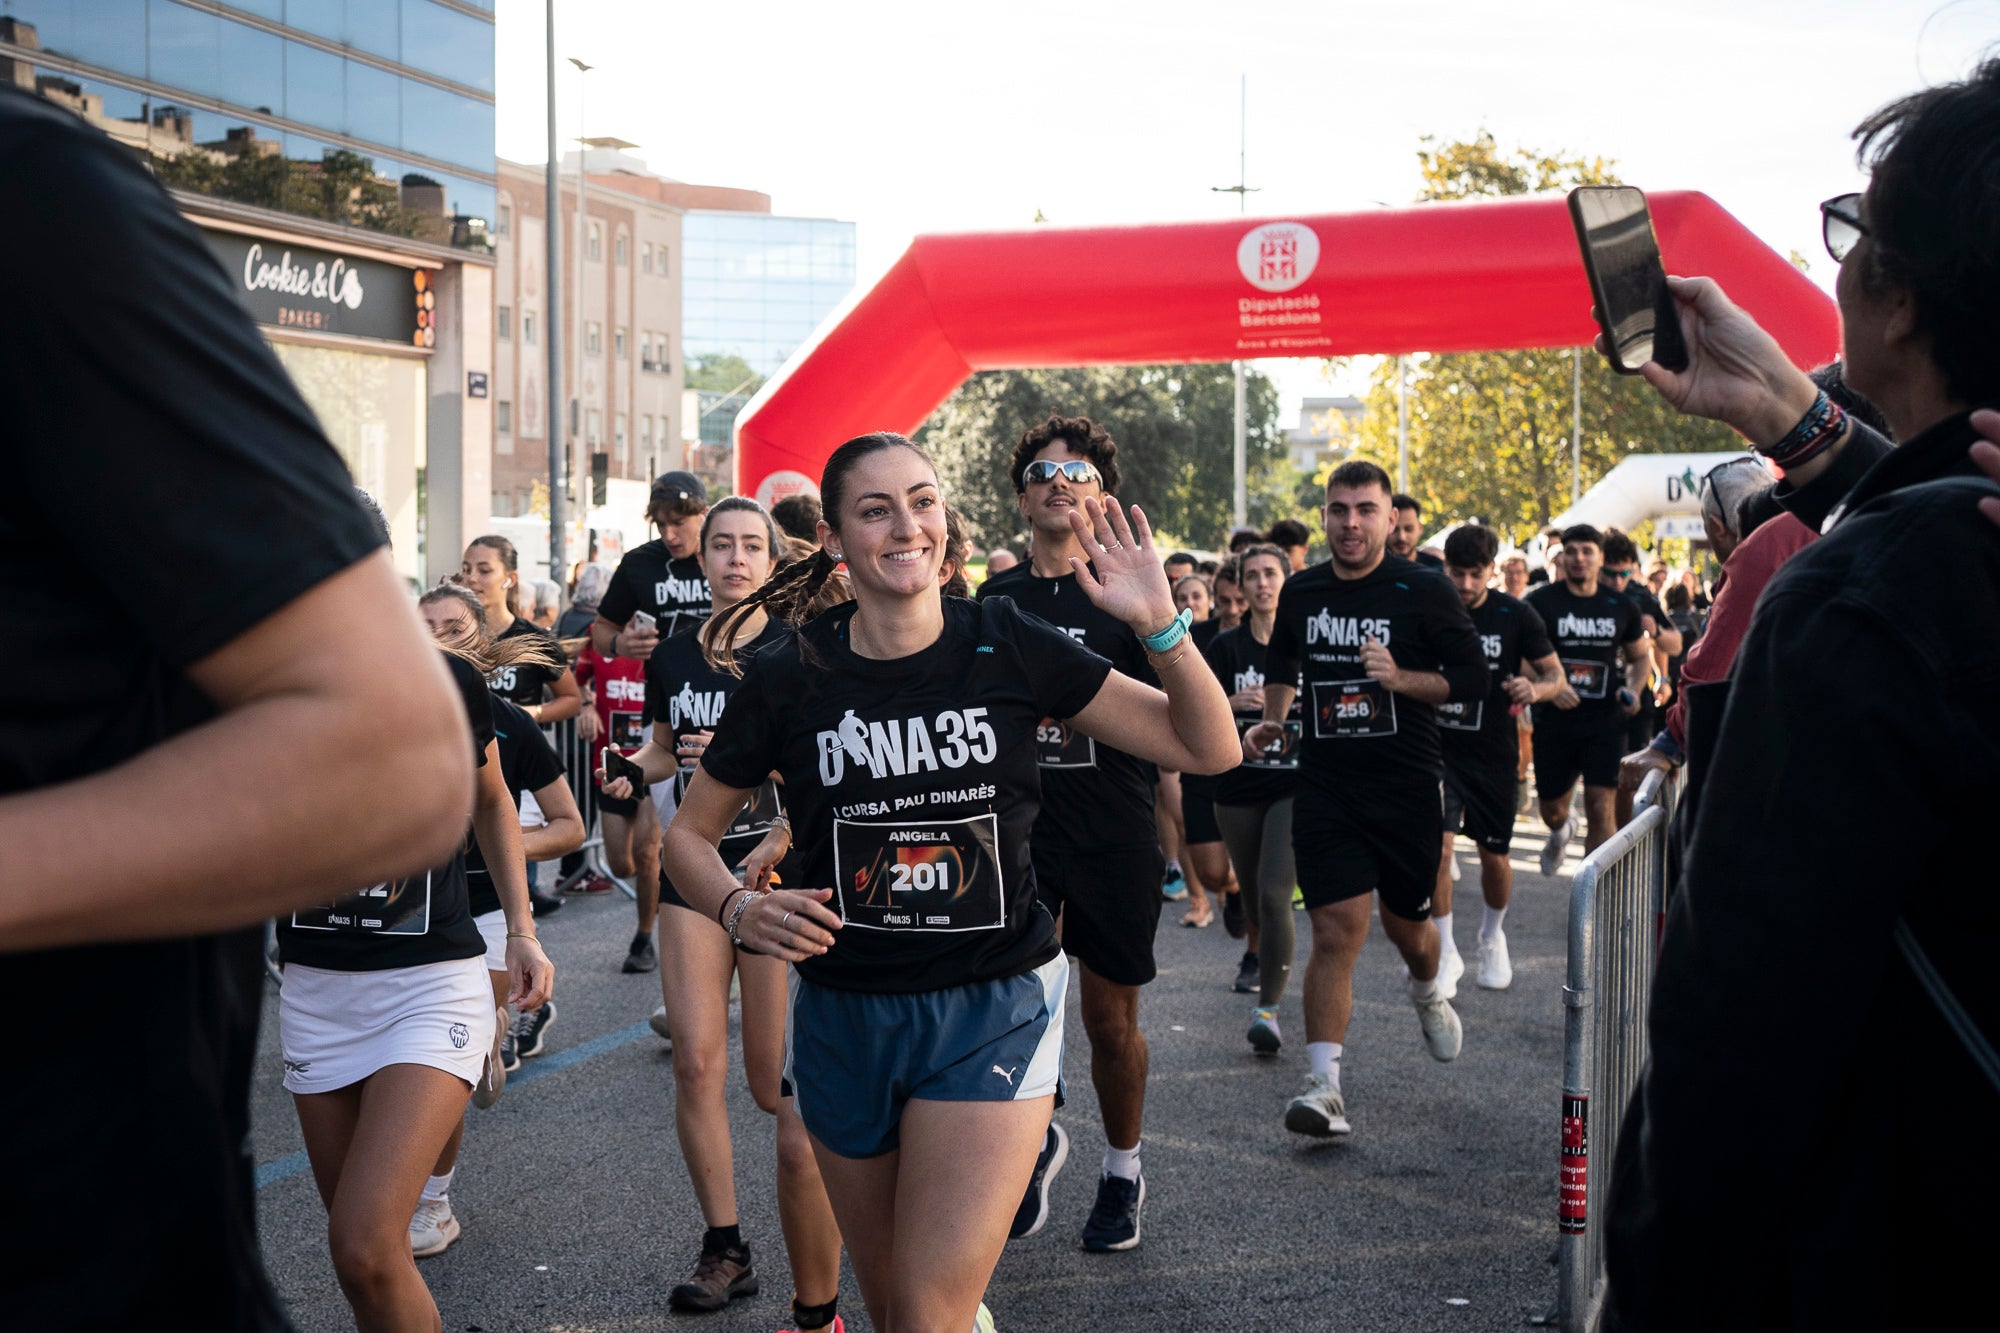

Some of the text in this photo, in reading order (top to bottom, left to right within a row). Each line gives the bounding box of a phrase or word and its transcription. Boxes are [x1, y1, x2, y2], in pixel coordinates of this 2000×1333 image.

[1238, 294, 1321, 313] Diputació
[1240, 312, 1321, 327] Barcelona
[1335, 702, 1370, 718] 258
[841, 800, 891, 818] CURSA
[894, 794, 925, 811] PAU
[930, 783, 996, 804] DINARÈS
[888, 831, 951, 842] ANGELA
[889, 862, 950, 891] 201
